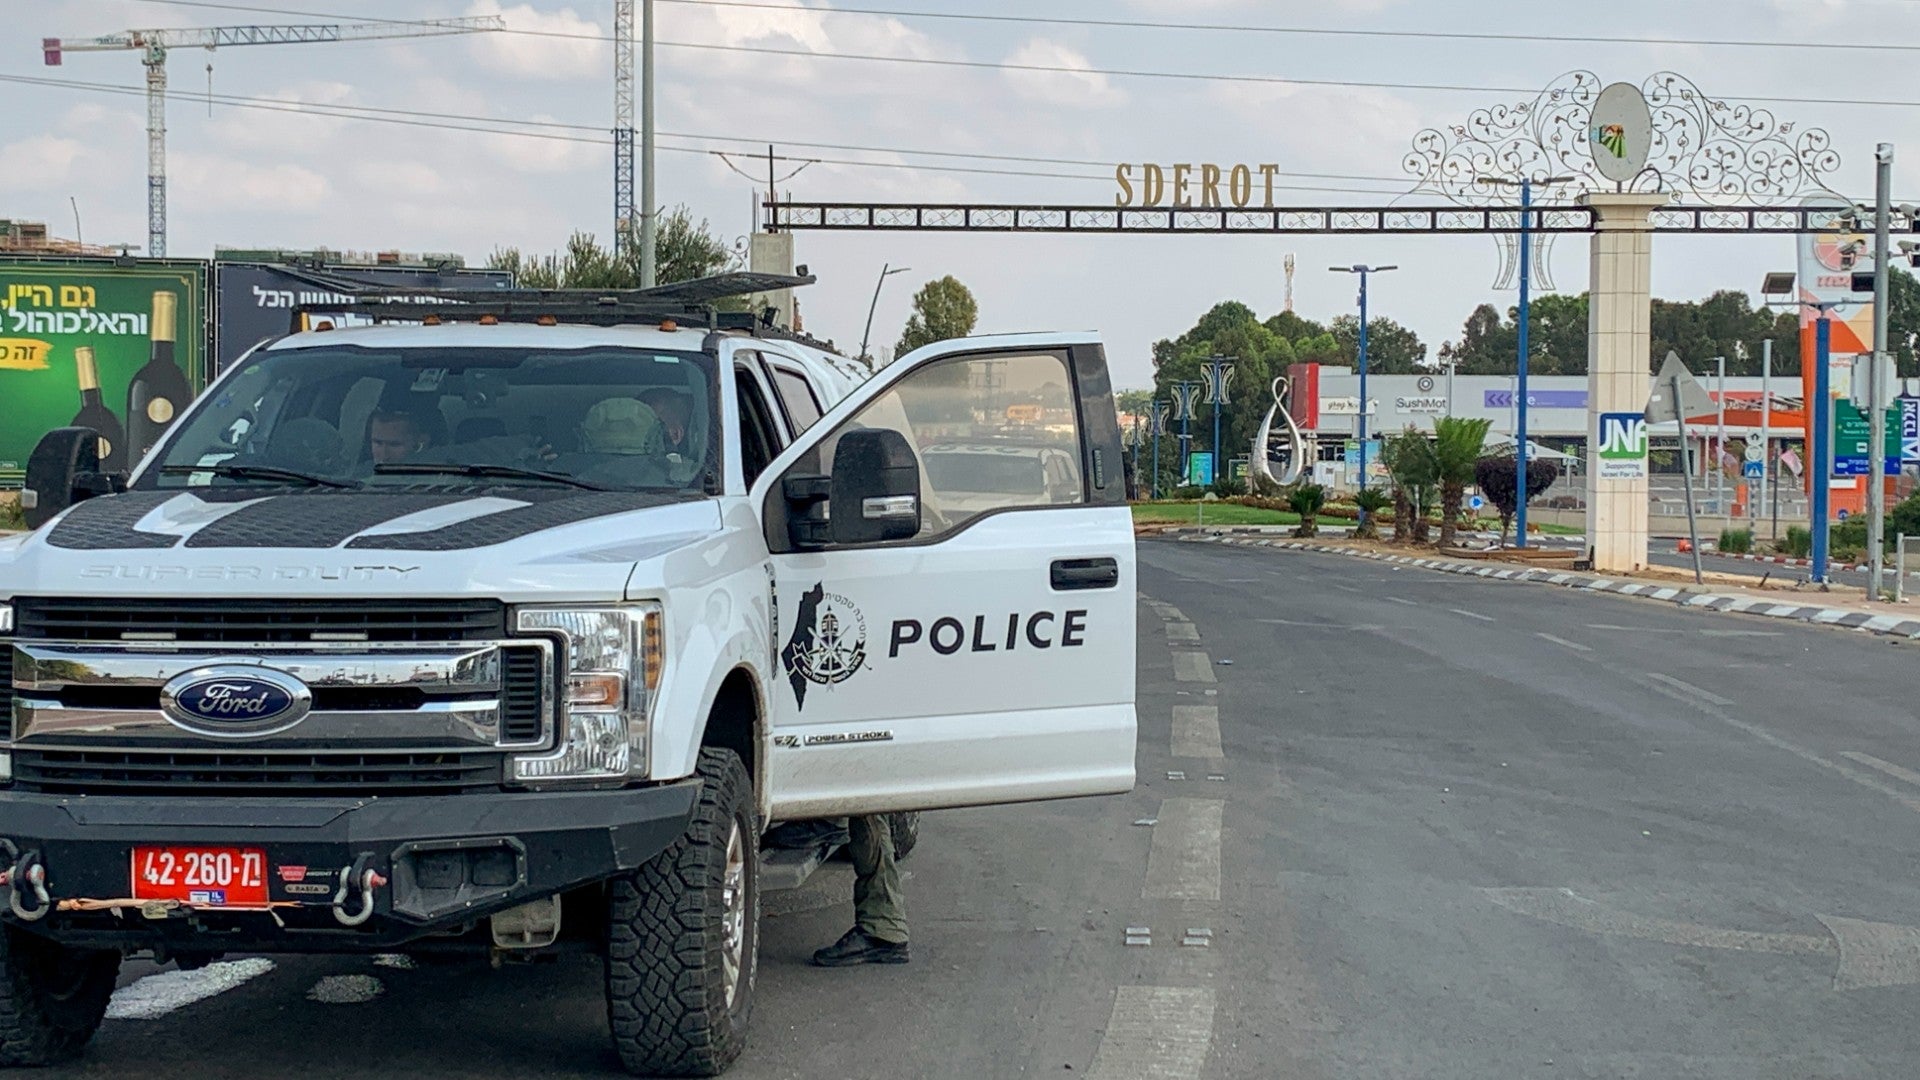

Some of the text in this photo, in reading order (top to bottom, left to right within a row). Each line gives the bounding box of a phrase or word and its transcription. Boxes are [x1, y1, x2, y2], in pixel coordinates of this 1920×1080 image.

[1116, 163, 1278, 207] SDEROT
[60, 285, 96, 308] גם
[253, 285, 295, 308] הכל
[8, 307, 148, 335] והאלכוהול
[14, 346, 37, 360] זה
[1396, 397, 1446, 408] SushiMot
[1605, 462, 1640, 470] Supporting
[80, 564, 421, 581] SUPER DUTY
[889, 609, 1088, 658] POLICE
[198, 684, 269, 713] Ford
[808, 733, 846, 743] POWER
[848, 730, 890, 740] STROKE
